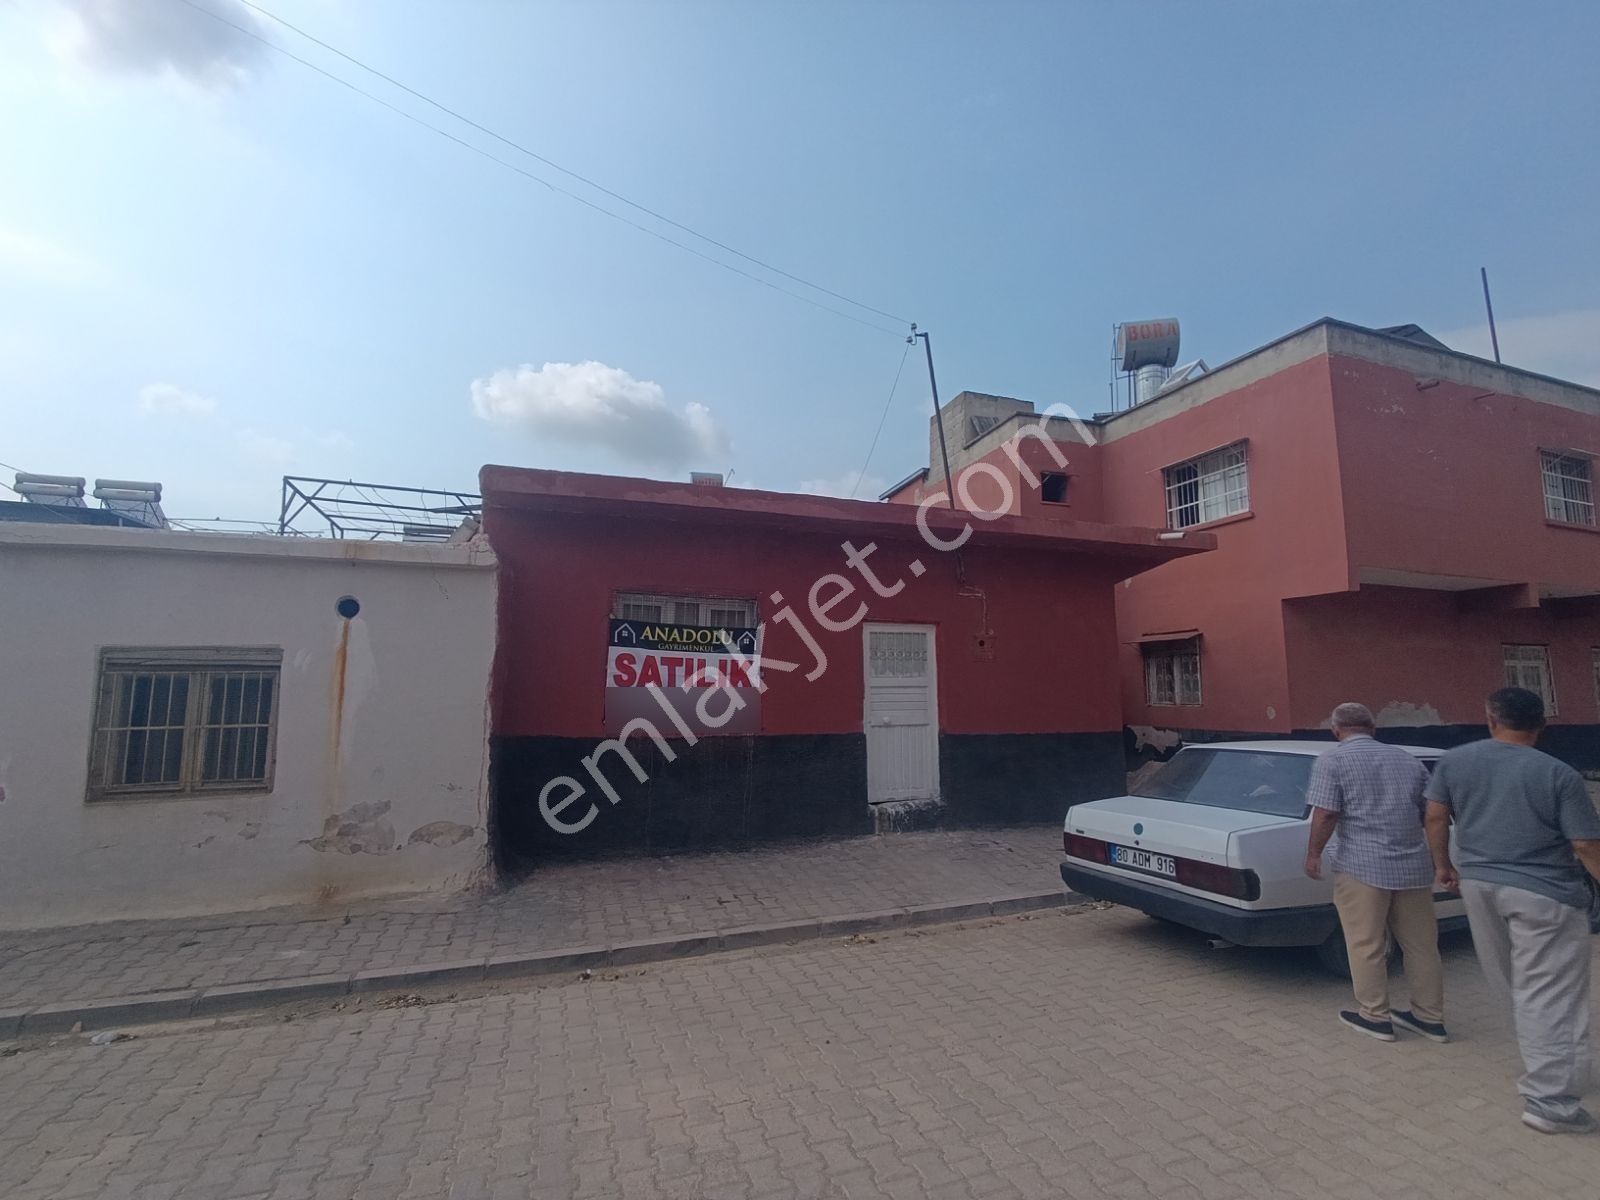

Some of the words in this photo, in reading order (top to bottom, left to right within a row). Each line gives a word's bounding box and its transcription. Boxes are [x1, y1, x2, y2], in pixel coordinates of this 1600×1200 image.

[1128, 322, 1177, 341] BORA
[640, 625, 733, 645] ANADOLU
[613, 652, 755, 688] SATILIK
[1117, 848, 1128, 863] 80
[1132, 851, 1151, 869] ADM
[1157, 856, 1175, 874] 916
